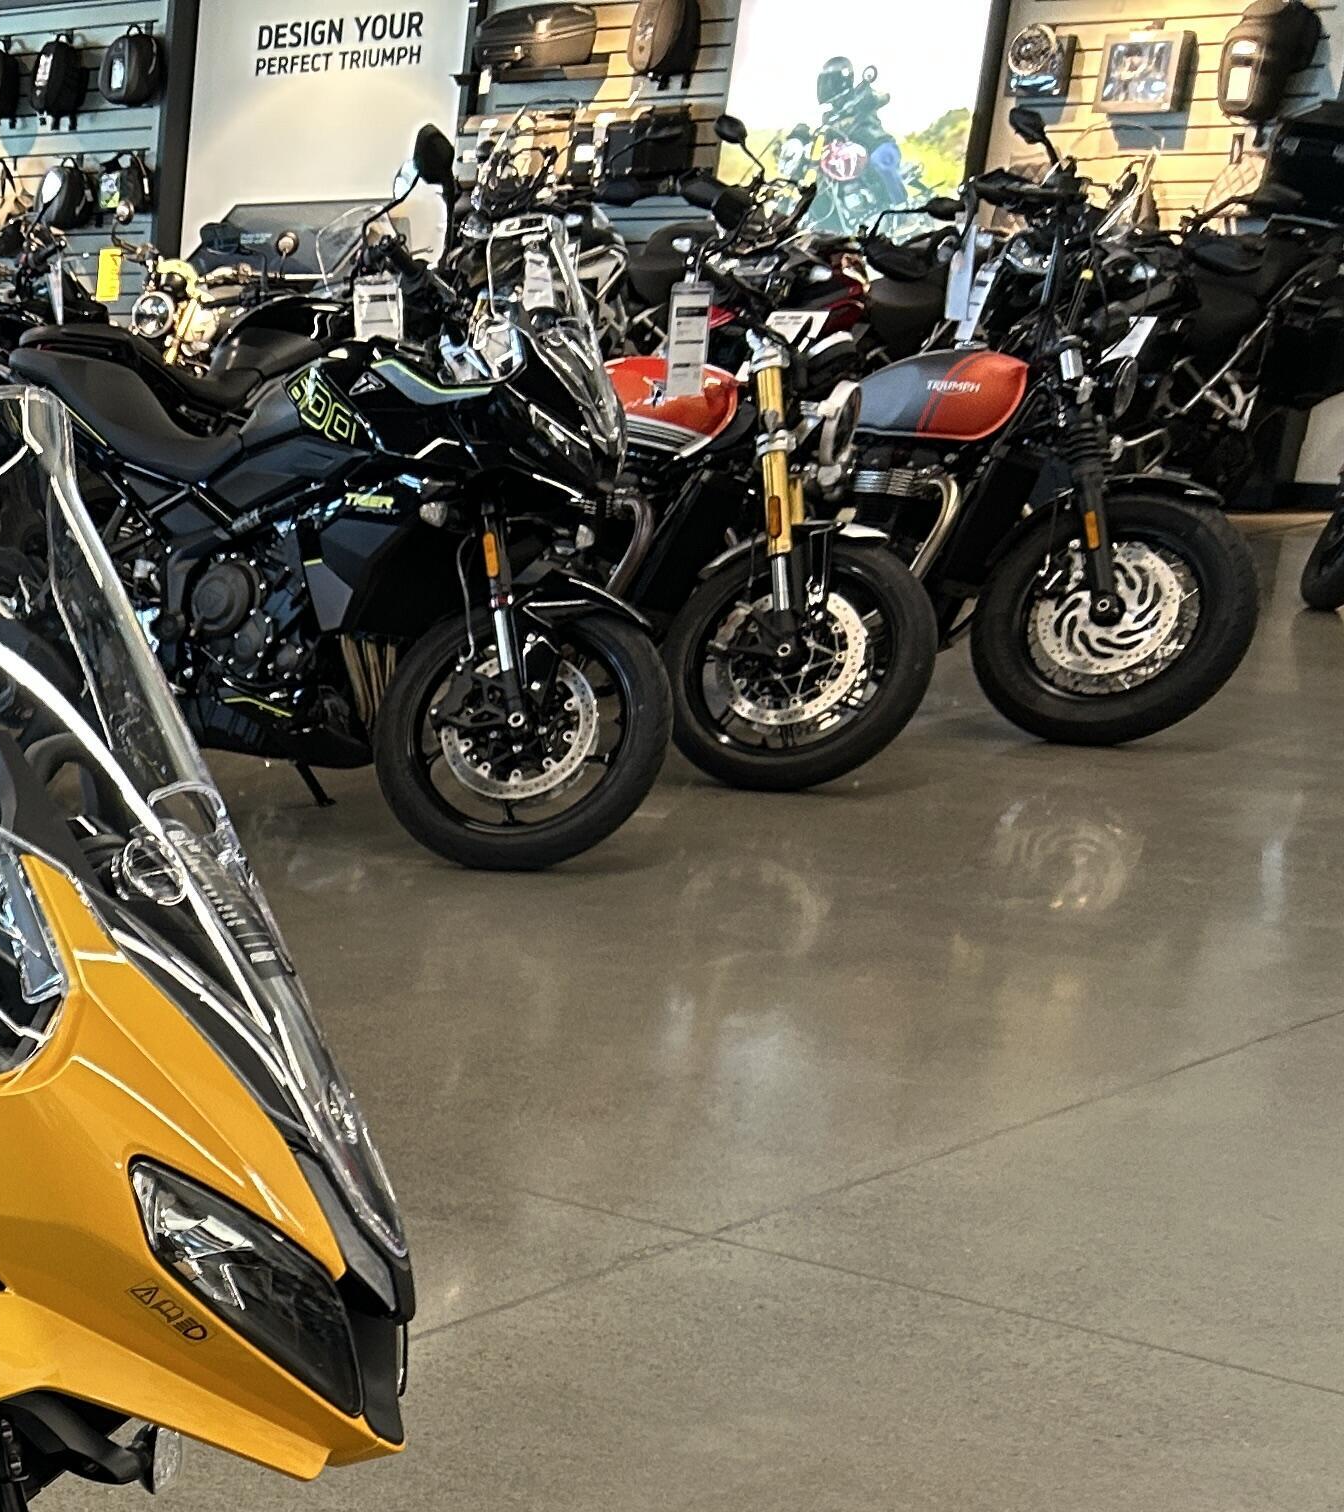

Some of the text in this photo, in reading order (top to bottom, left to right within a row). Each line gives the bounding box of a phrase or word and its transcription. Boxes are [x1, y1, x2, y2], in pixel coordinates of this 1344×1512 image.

[257, 11, 424, 50] DESIGN YOUR
[255, 45, 422, 76] PERFECT TRIUMPH
[926, 380, 981, 393] TRIUMPH
